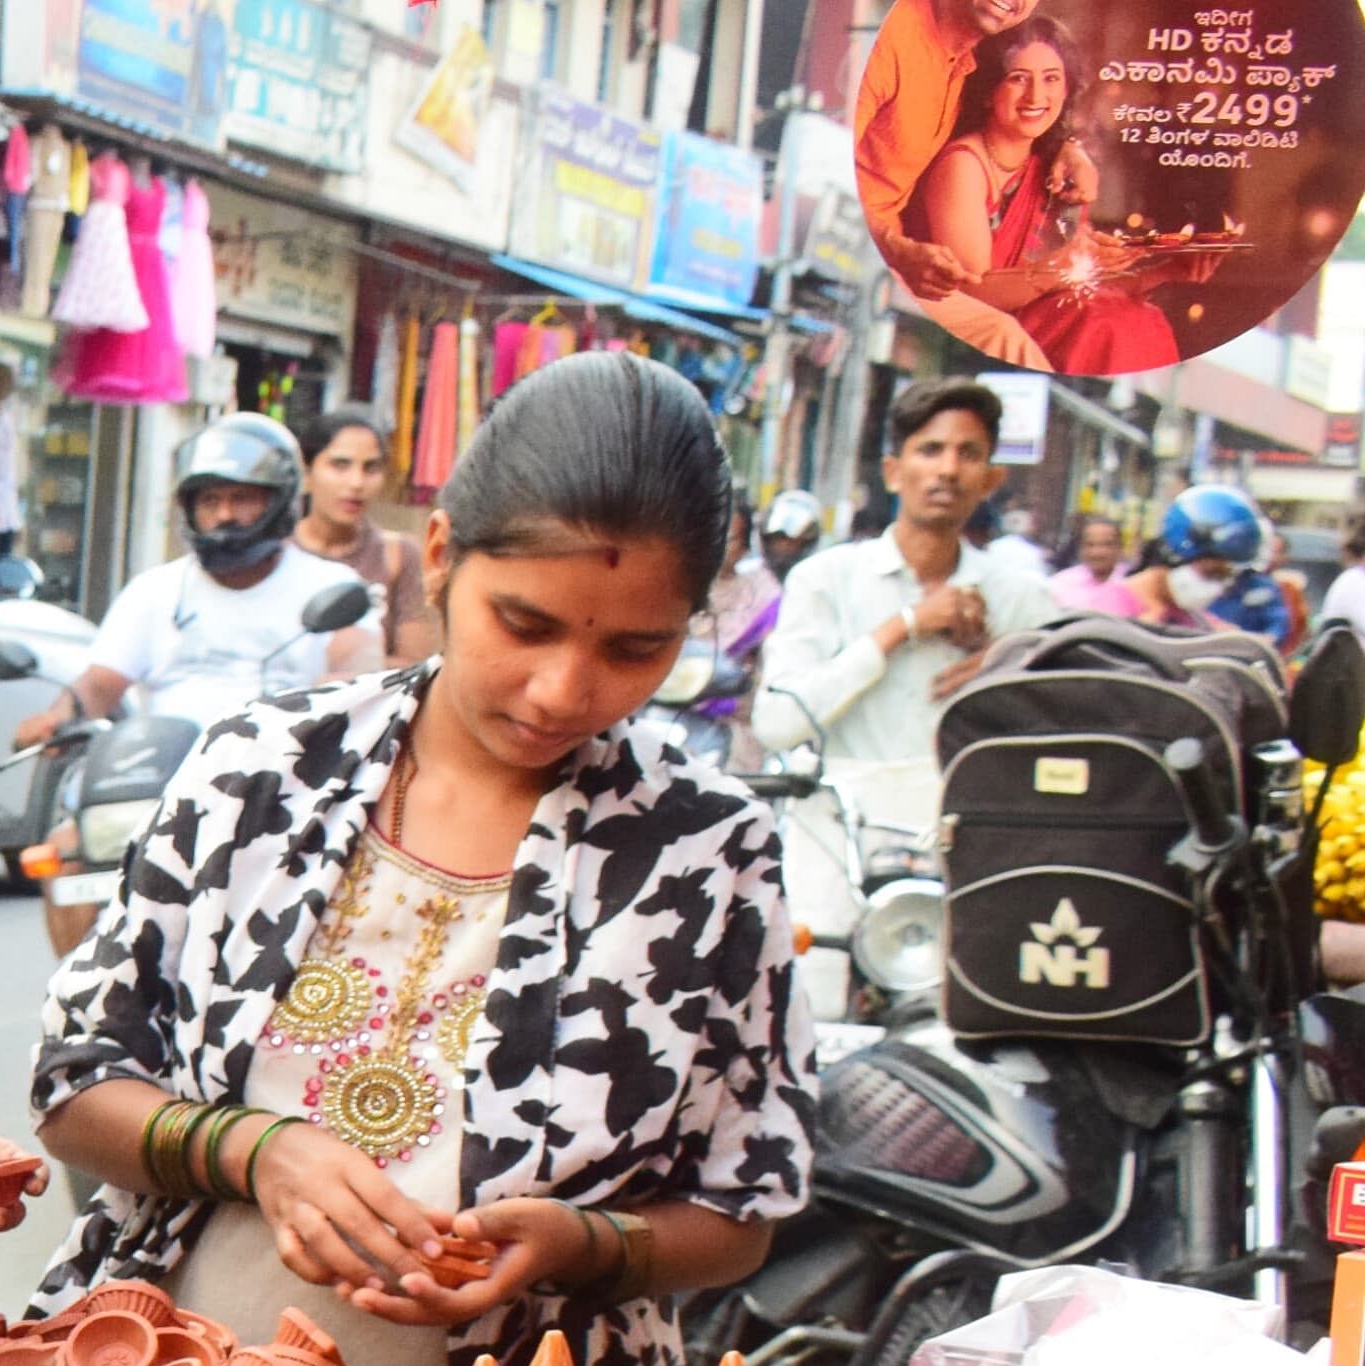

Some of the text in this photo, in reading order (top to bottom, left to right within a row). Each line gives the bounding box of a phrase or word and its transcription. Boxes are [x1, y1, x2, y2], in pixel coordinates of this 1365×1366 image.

[1194, 9, 1254, 26] ಇದೀಗ
[1147, 28, 1294, 60] HD ಕನ್ನಡ
[1099, 57, 1338, 92] ಎಕಾನಮಿ ಪ್ಯಾಕ್
[1112, 104, 1171, 122] ಕೇವಲ
[1120, 127, 1299, 149] 12 ತಿಂಗಳ ವಾಲಿಡಿಟಿ
[1019, 941, 1110, 989] NH
